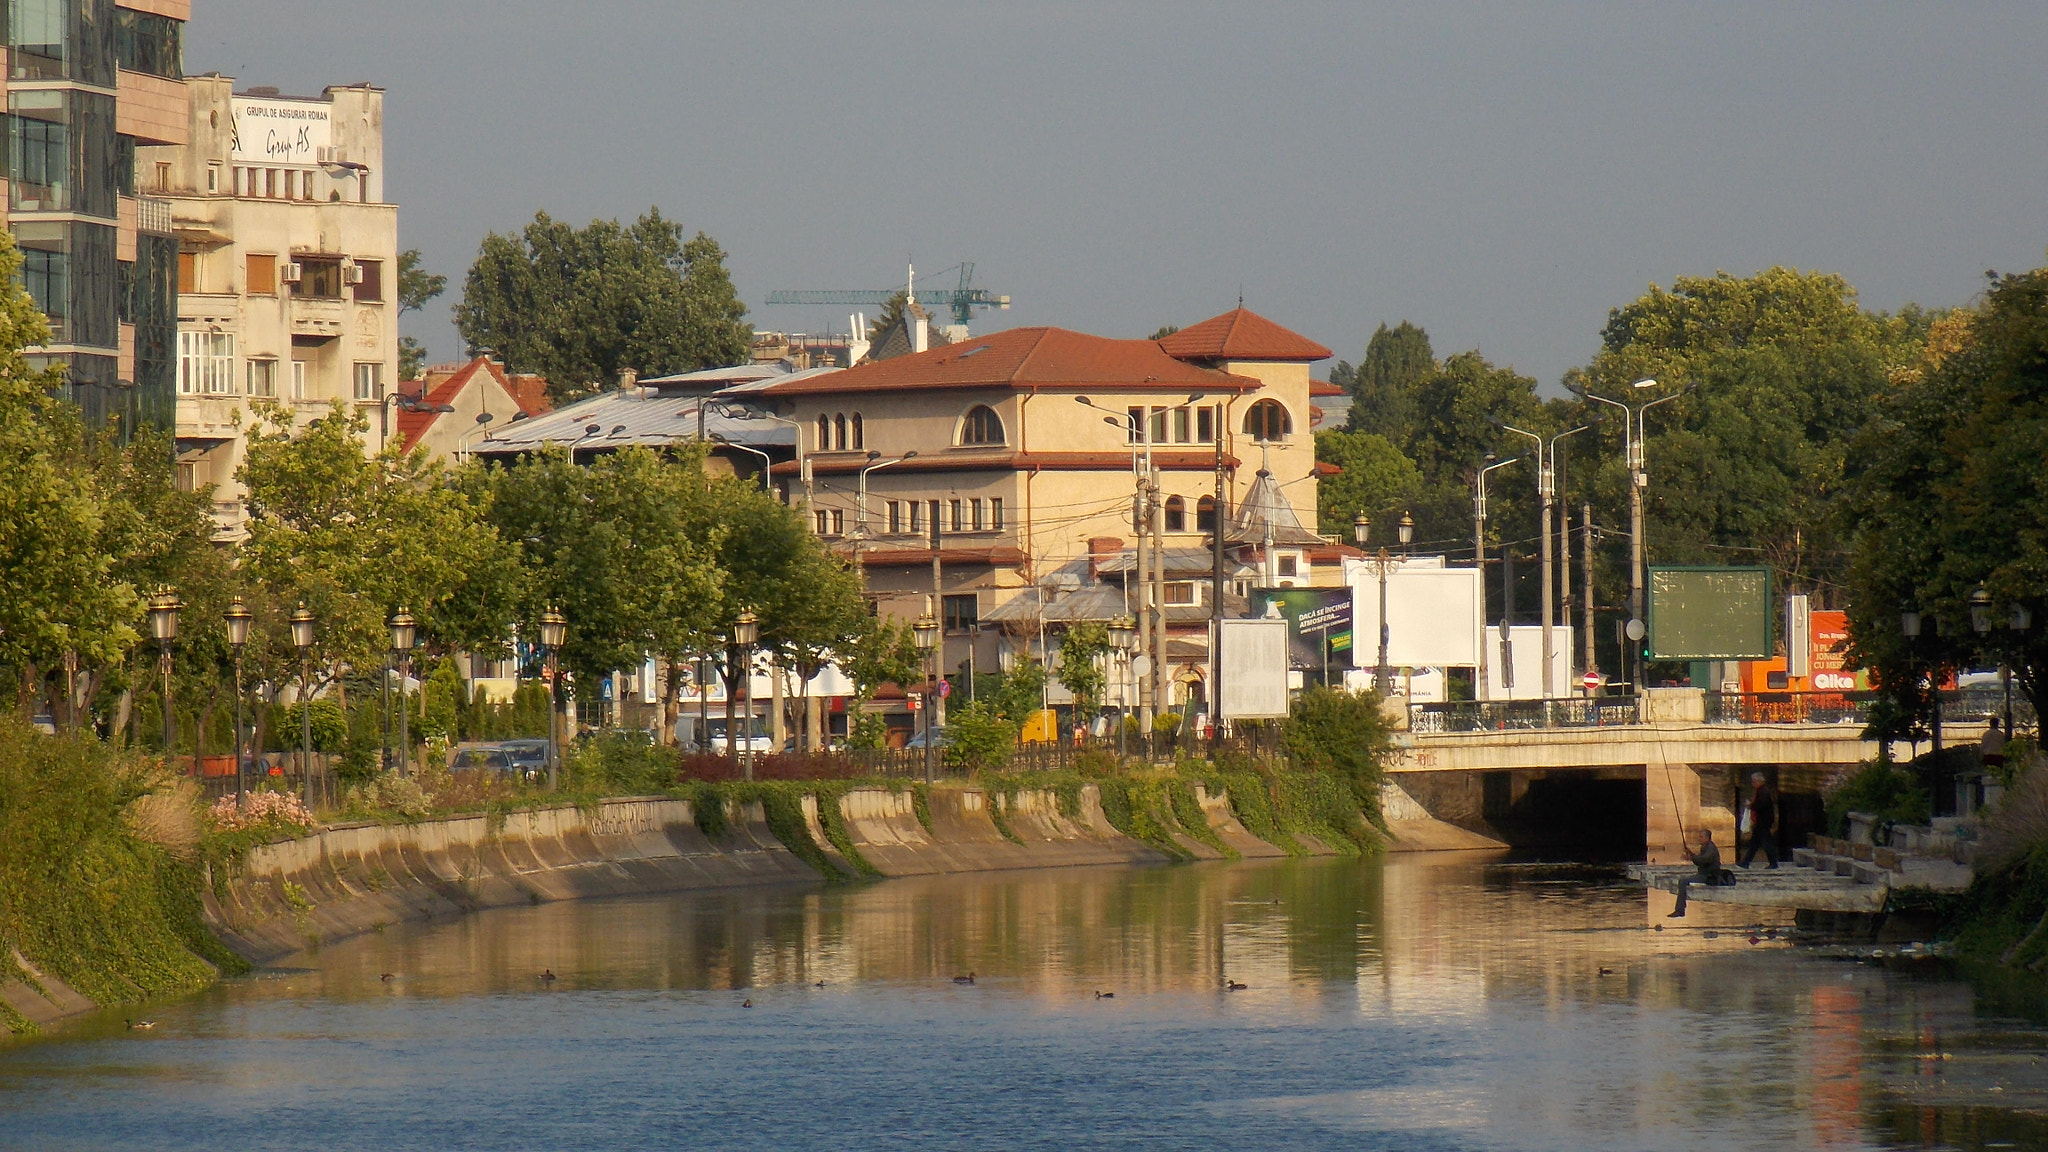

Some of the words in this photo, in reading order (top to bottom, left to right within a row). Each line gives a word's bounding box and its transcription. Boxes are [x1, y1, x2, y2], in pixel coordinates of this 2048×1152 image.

[246, 106, 269, 118] GRUPUL
[270, 108, 277, 118] DE
[308, 111, 328, 121] ROMAN
[266, 129, 292, 161] Grup
[296, 125, 310, 154] AS
[1316, 608, 1324, 616] SE
[1813, 661, 1825, 669] CU
